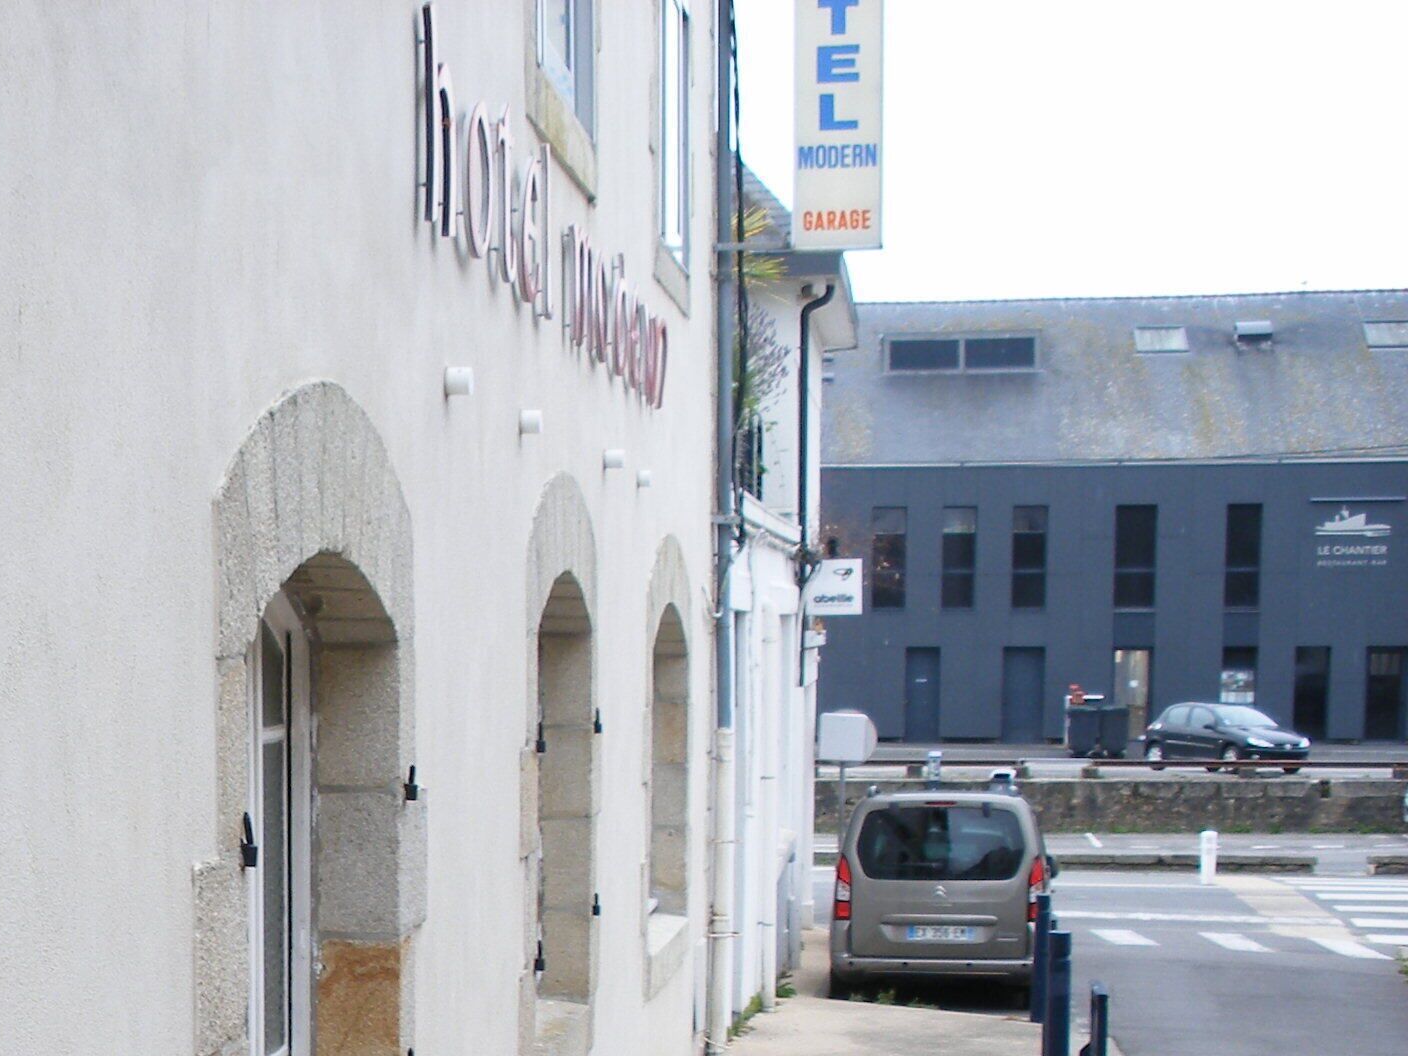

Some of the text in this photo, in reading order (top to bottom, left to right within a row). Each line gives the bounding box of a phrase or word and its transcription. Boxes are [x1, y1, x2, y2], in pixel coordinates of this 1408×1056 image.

[797, 144, 878, 170] MODERN
[422, 2, 668, 410] hotel modern
[802, 209, 872, 231] GARAGE
[1317, 545, 1388, 556] LE CHANTIER
